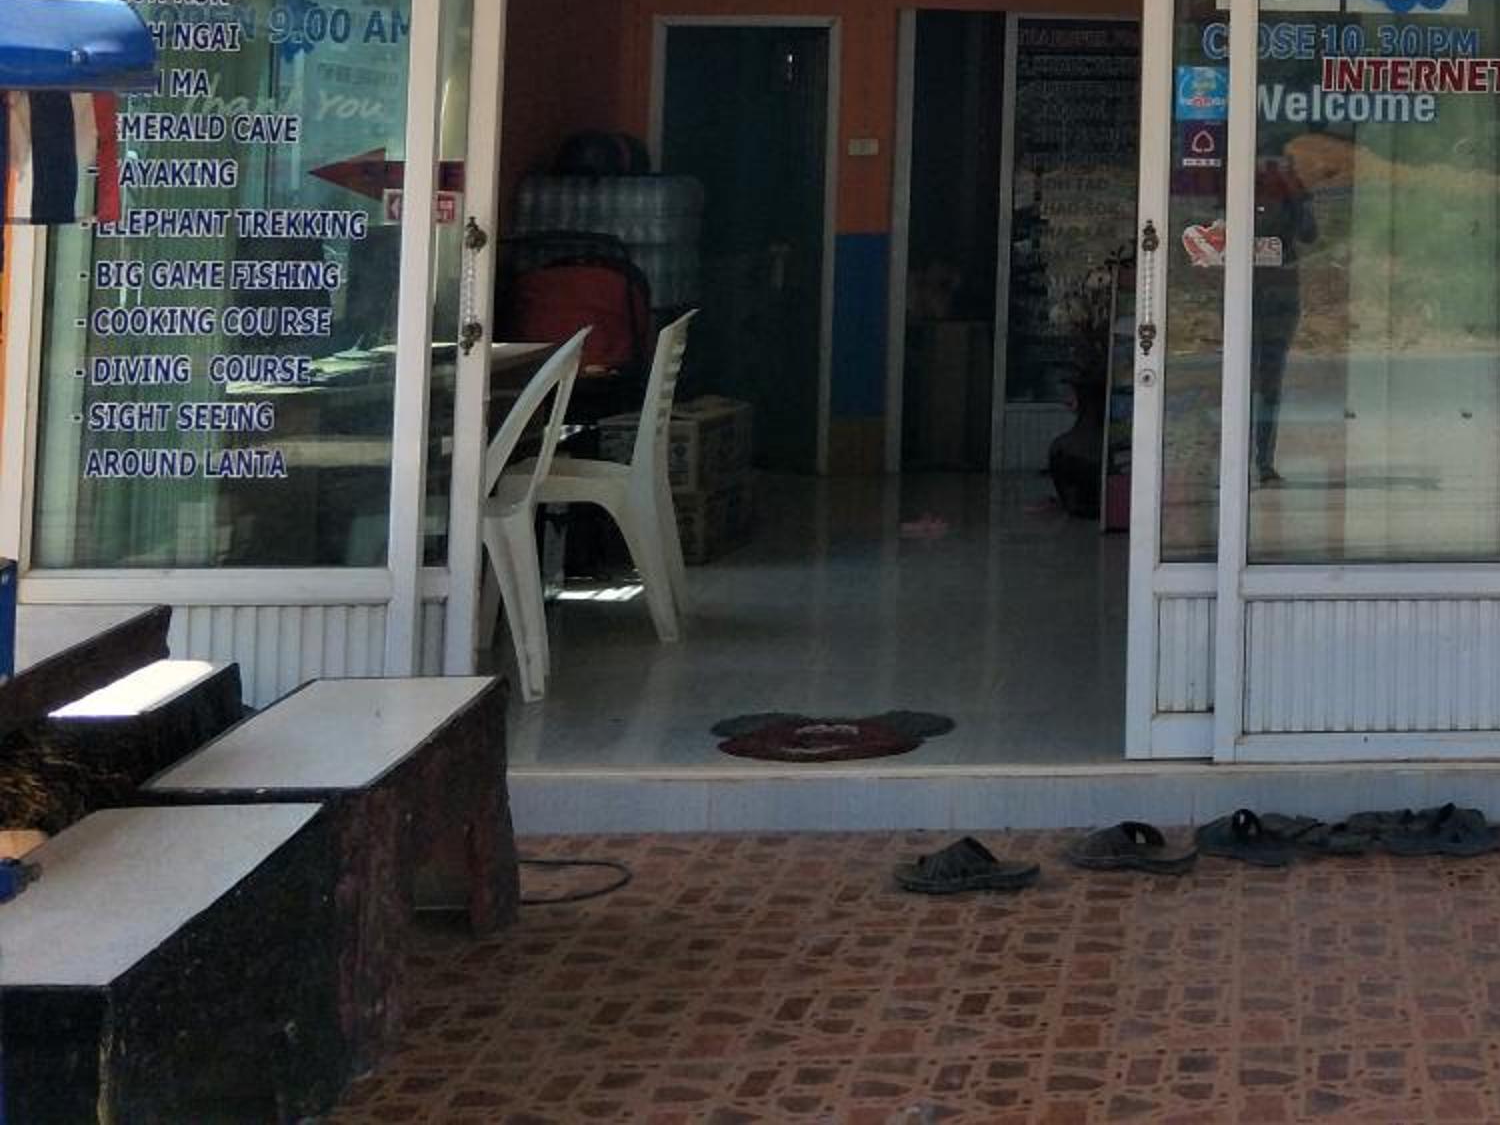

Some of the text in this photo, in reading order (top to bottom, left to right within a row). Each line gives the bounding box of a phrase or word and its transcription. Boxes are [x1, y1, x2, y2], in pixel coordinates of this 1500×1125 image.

[172, 22, 241, 52] NGAI
[1202, 22, 1318, 60] CSE
[169, 68, 211, 98] MA
[116, 114, 299, 143] MERALD CAVE
[118, 159, 238, 188] AYAKING
[234, 210, 368, 240] TREKKING
[95, 260, 341, 291] BIG GAME FISHING
[93, 306, 333, 336] COOKING COURSE
[91, 355, 312, 385] DIVING COURSE
[88, 403, 275, 432] SIGHT SEEING
[85, 448, 288, 478] AROUND LANTA
